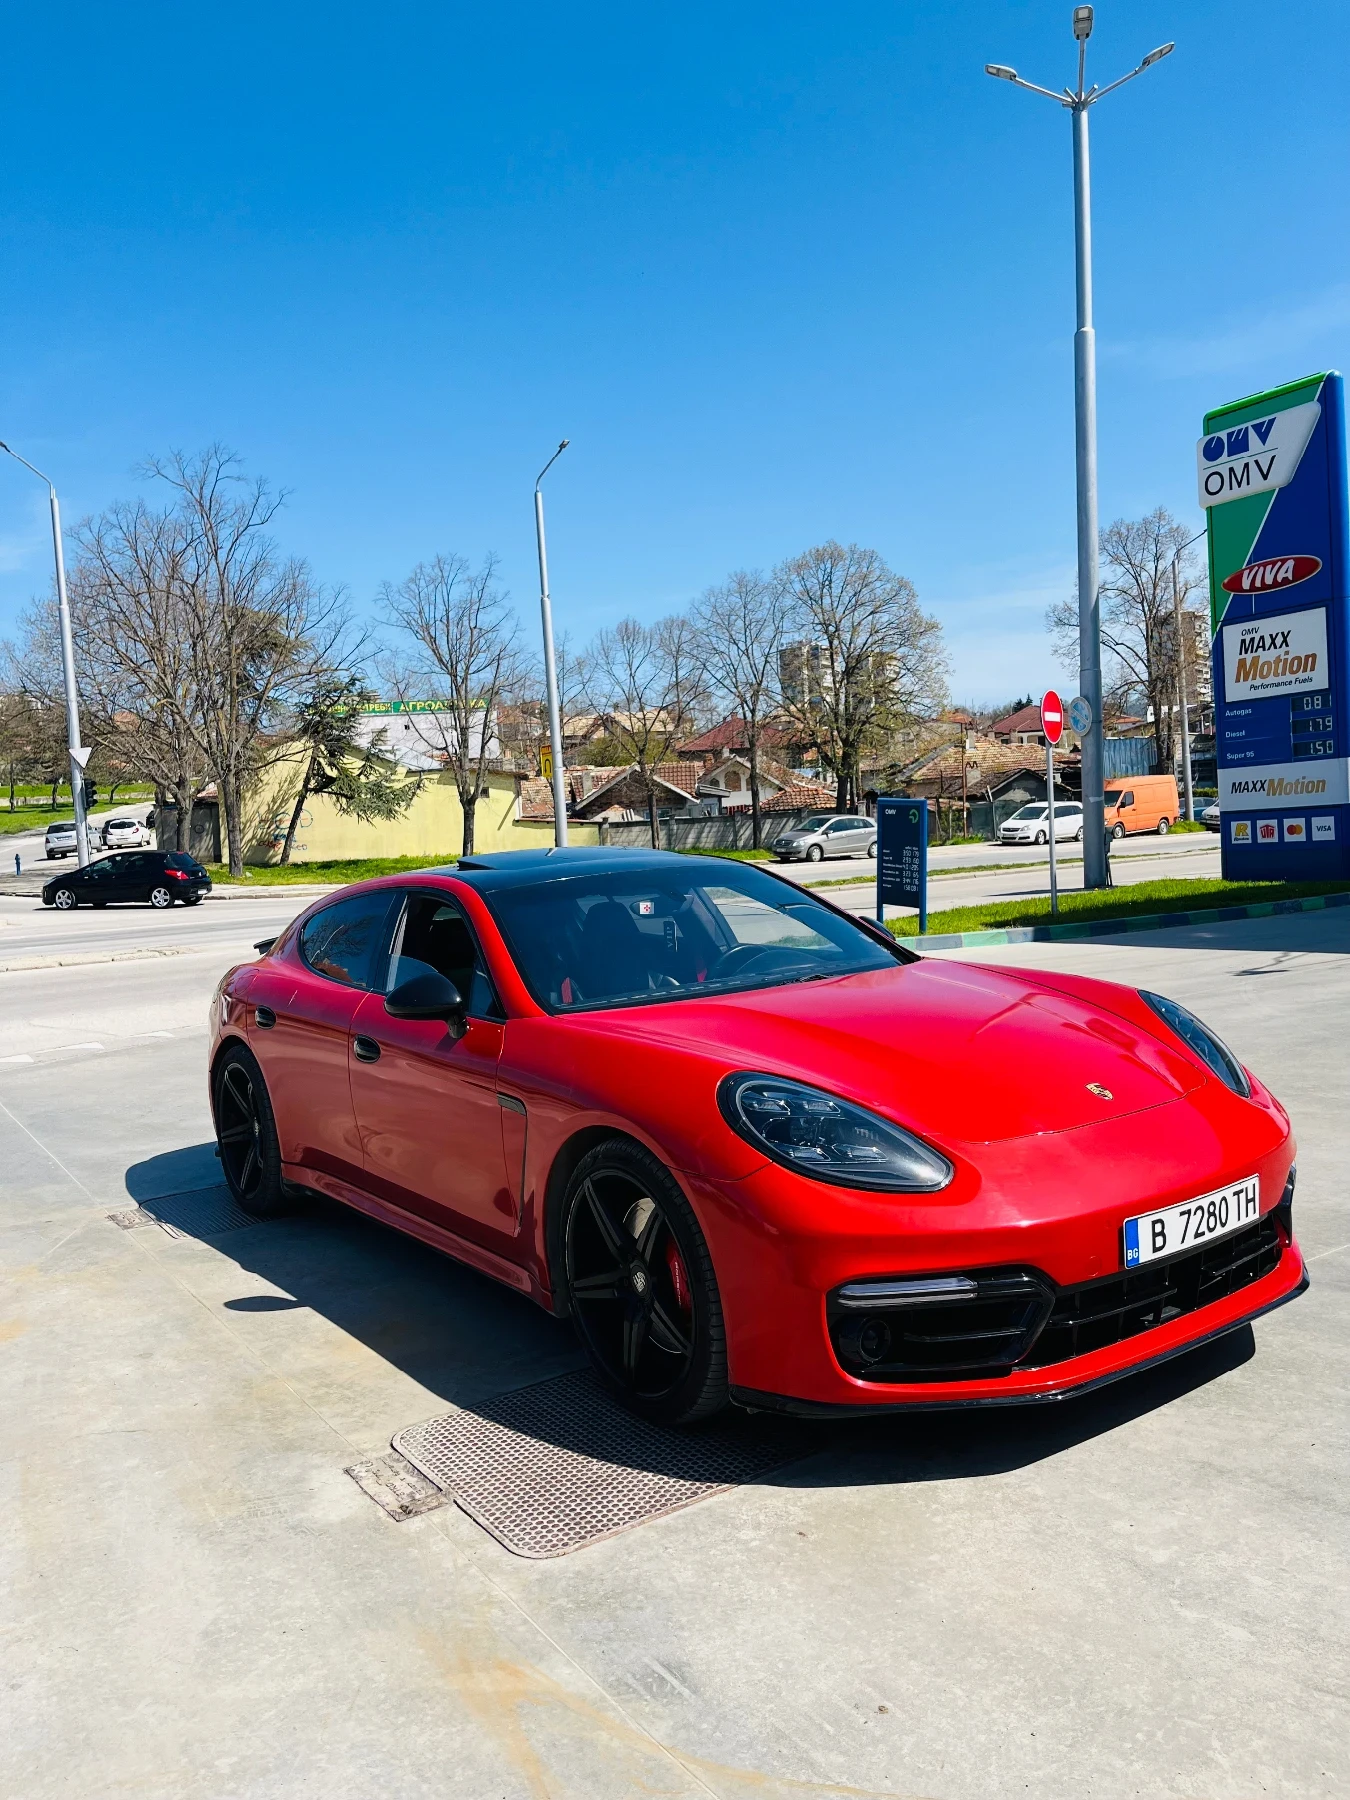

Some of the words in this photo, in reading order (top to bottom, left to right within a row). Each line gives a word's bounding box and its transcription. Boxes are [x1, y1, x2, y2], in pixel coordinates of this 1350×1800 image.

[1204, 454, 1277, 496] OMV
[1241, 558, 1295, 590] VIVA
[1241, 626, 1260, 637] OMV
[1239, 630, 1292, 656] MAXX
[1234, 650, 1318, 684] Motion
[1249, 679, 1293, 692] Performance
[1294, 675, 1314, 686] Fuels
[1225, 708, 1252, 717] Autogas
[1225, 729, 1246, 738] Diesel
[1309, 717, 1332, 732] 1.79
[1226, 752, 1245, 760] Super
[1245, 750, 1255, 758] 95
[1310, 740, 1333, 755] 1.50
[1151, 1218, 1167, 1254] B
[1178, 1195, 1229, 1245] 7280
[1232, 1183, 1257, 1222] TH
[1127, 1248, 1139, 1261] BG
